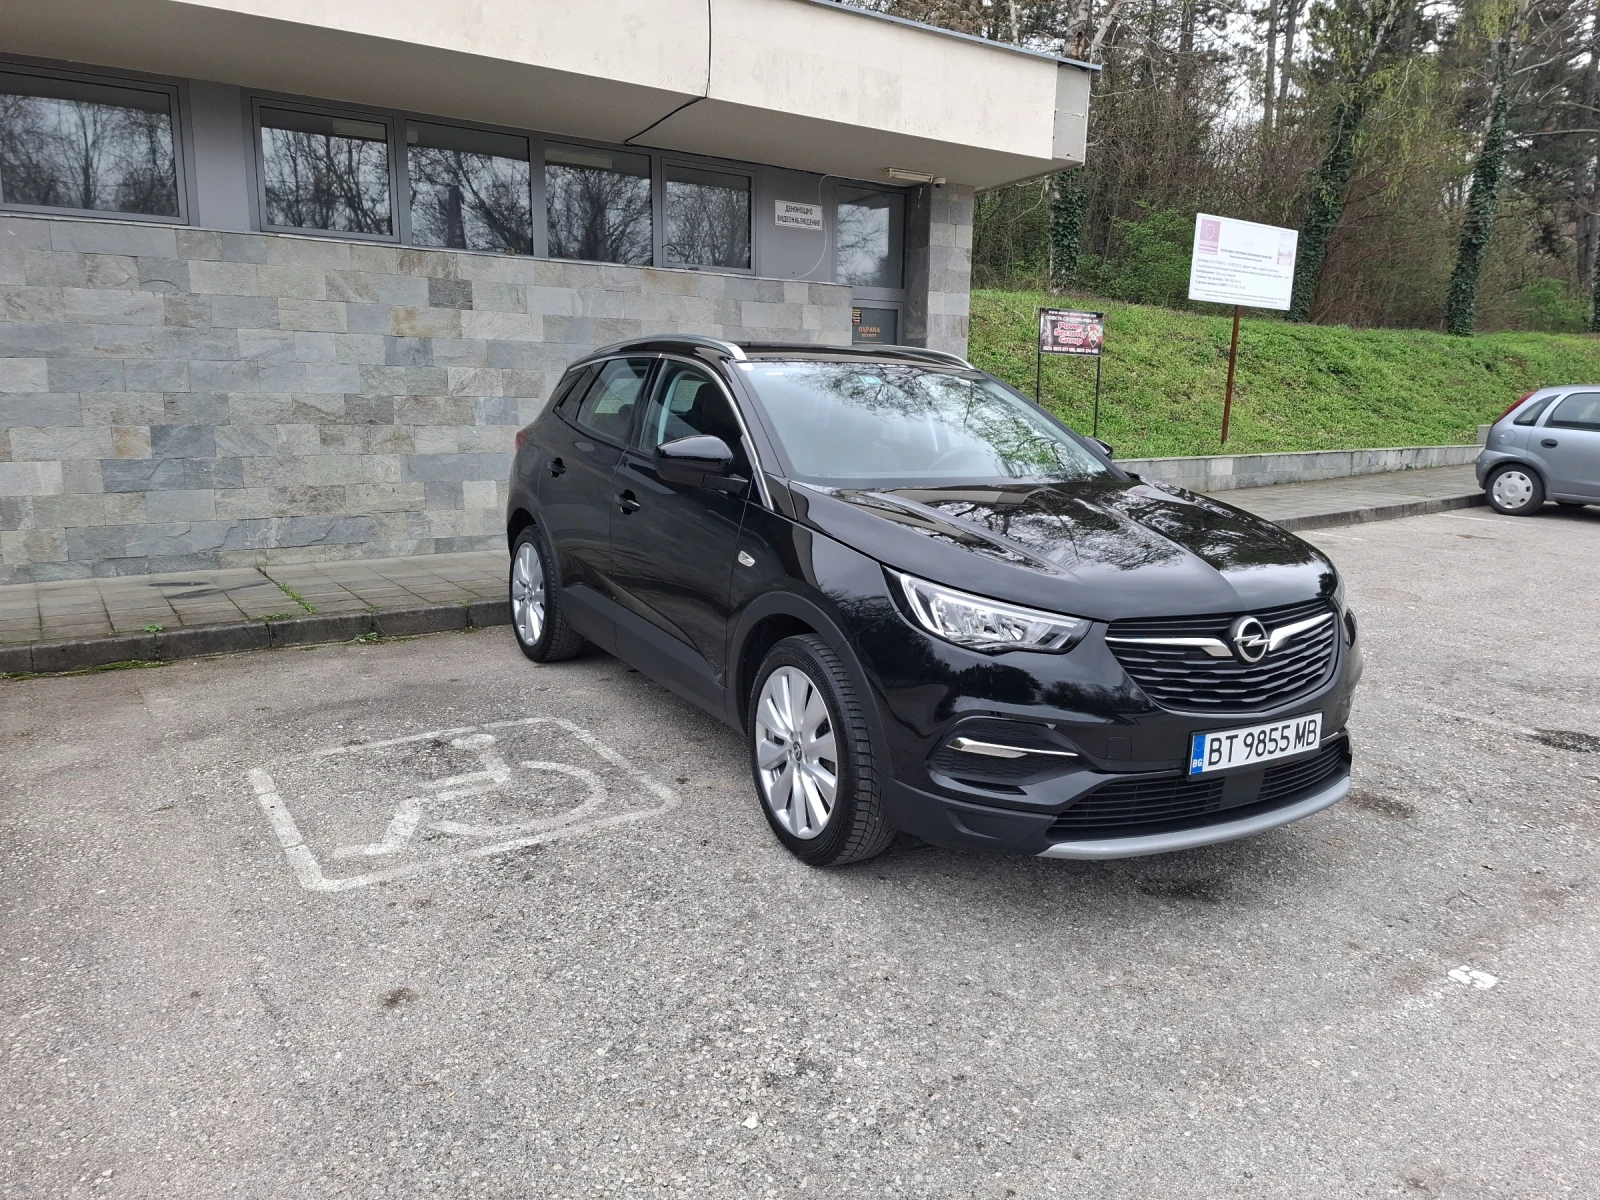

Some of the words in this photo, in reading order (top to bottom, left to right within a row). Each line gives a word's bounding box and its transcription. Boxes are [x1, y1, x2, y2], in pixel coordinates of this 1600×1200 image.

[785, 204, 813, 215] ДЕНОНОЩНО
[777, 214, 821, 227] ВИДЕОНАБЛЮДЕНИЕ
[1058, 322, 1085, 330] Power
[1054, 328, 1088, 339] Security
[1059, 336, 1083, 345] Group
[1208, 734, 1239, 767] BT
[1243, 724, 1291, 760] 9855
[1293, 719, 1317, 749] MB
[1192, 758, 1203, 768] BG
